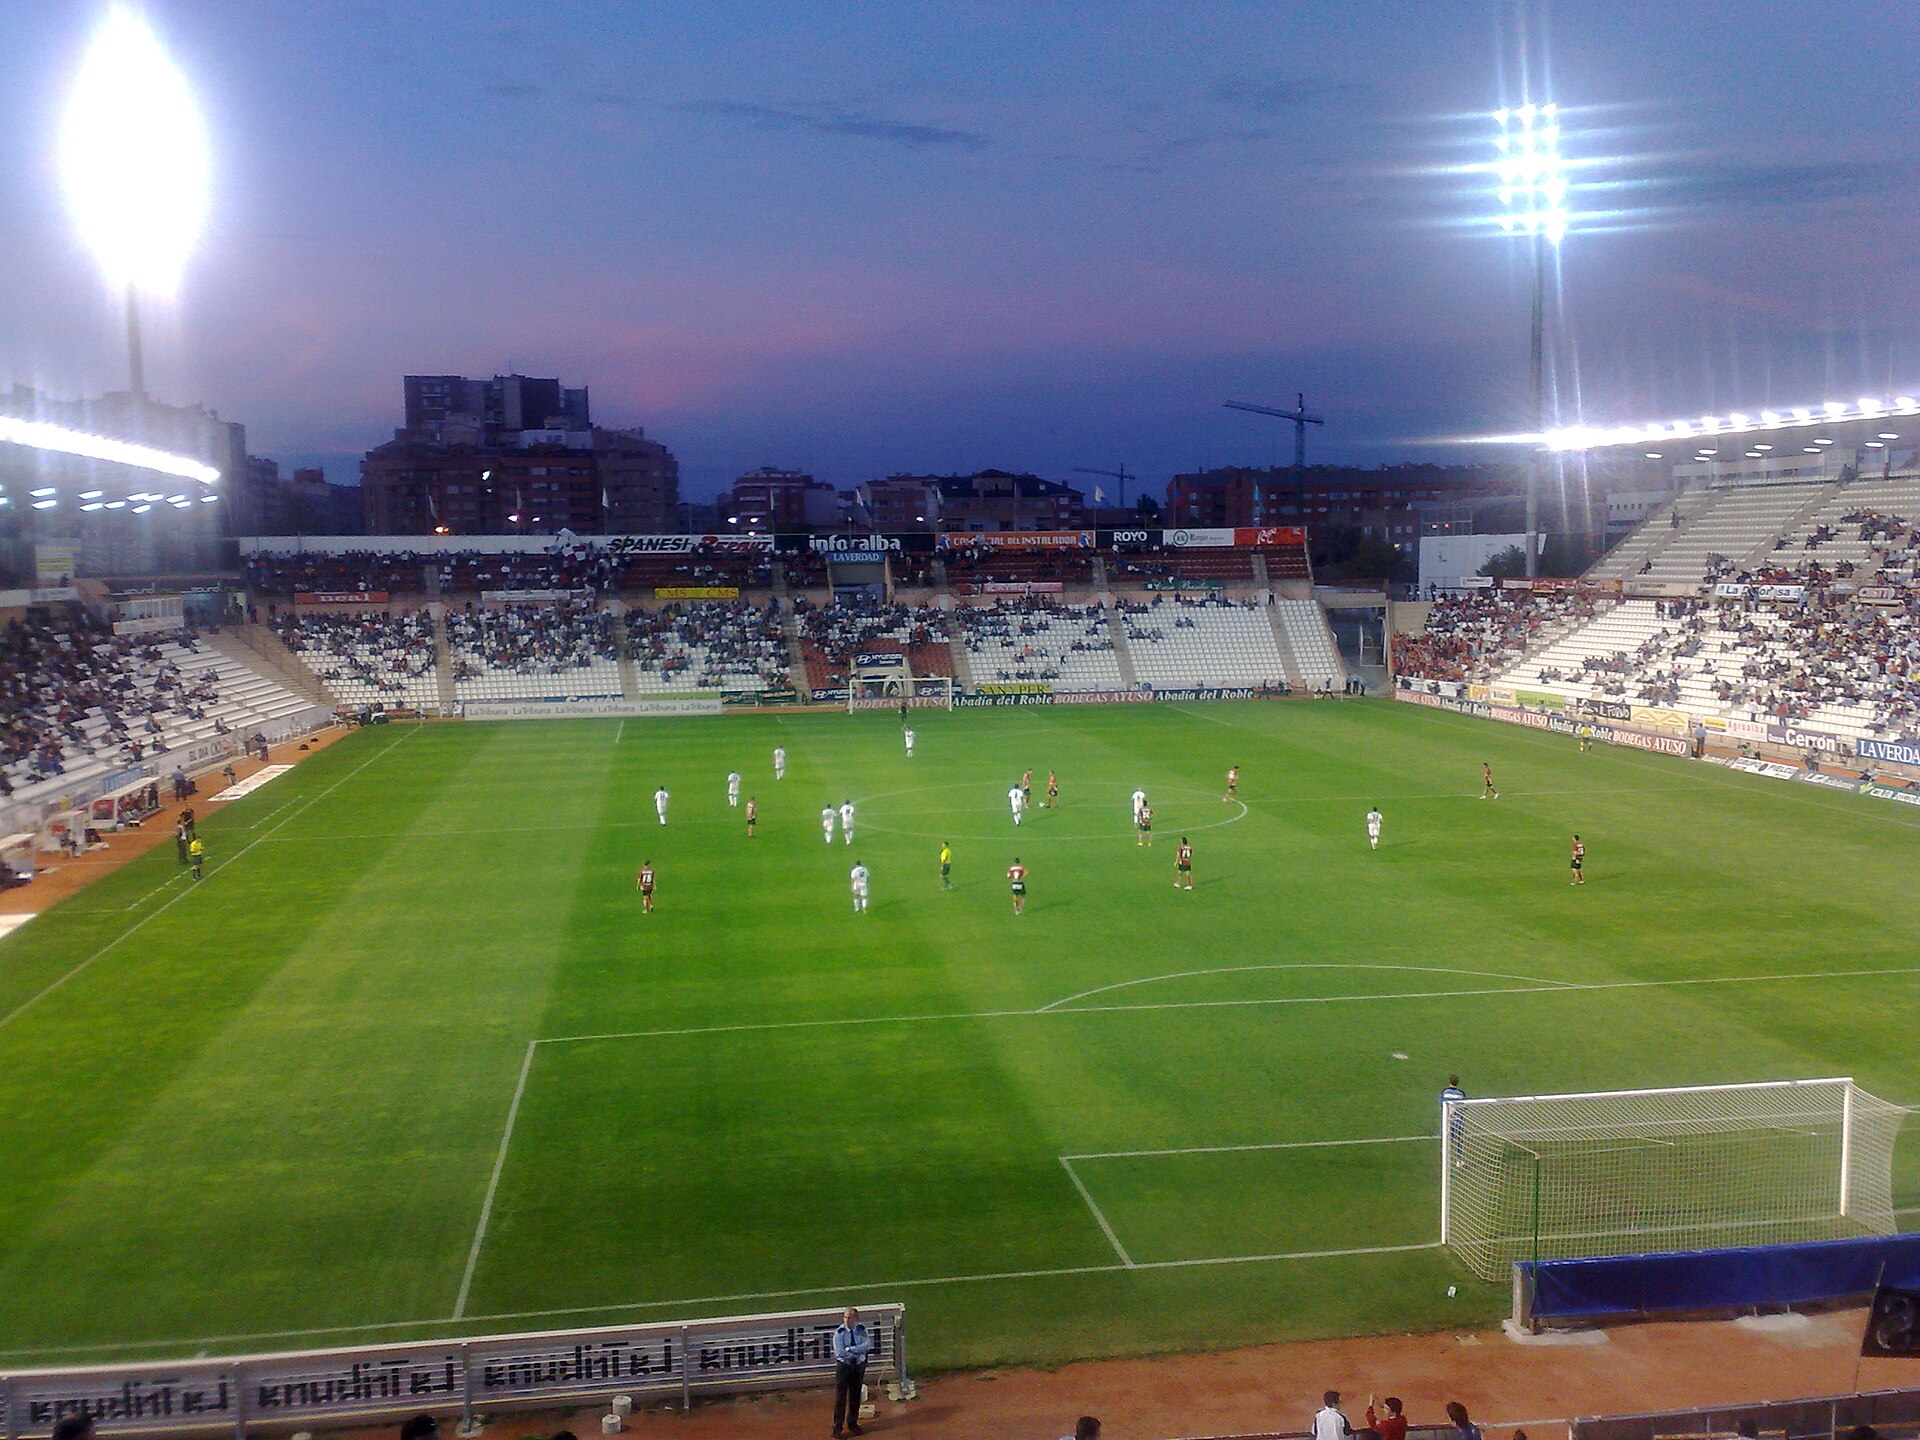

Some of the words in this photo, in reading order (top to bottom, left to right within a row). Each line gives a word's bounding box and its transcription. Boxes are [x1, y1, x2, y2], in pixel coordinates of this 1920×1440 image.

[1022, 536, 1077, 545] INSTALADOR
[1113, 531, 1148, 542] ROYO
[1726, 585, 1739, 594] La
[952, 695, 993, 707] Abadía
[996, 694, 1015, 706] del
[1020, 694, 1053, 705] Roble
[1054, 692, 1107, 703] BODEGAS
[1110, 691, 1153, 702] AYUSO
[1156, 690, 1195, 701] Abadía
[1199, 689, 1217, 700] del
[1221, 689, 1254, 699] Roble
[906, 696, 949, 707] AYUSO
[1491, 708, 1522, 723] BODEGAS
[1522, 713, 1548, 727] AYUSO
[1613, 730, 1652, 748] BODEGAS
[1654, 736, 1687, 755] AYUSO
